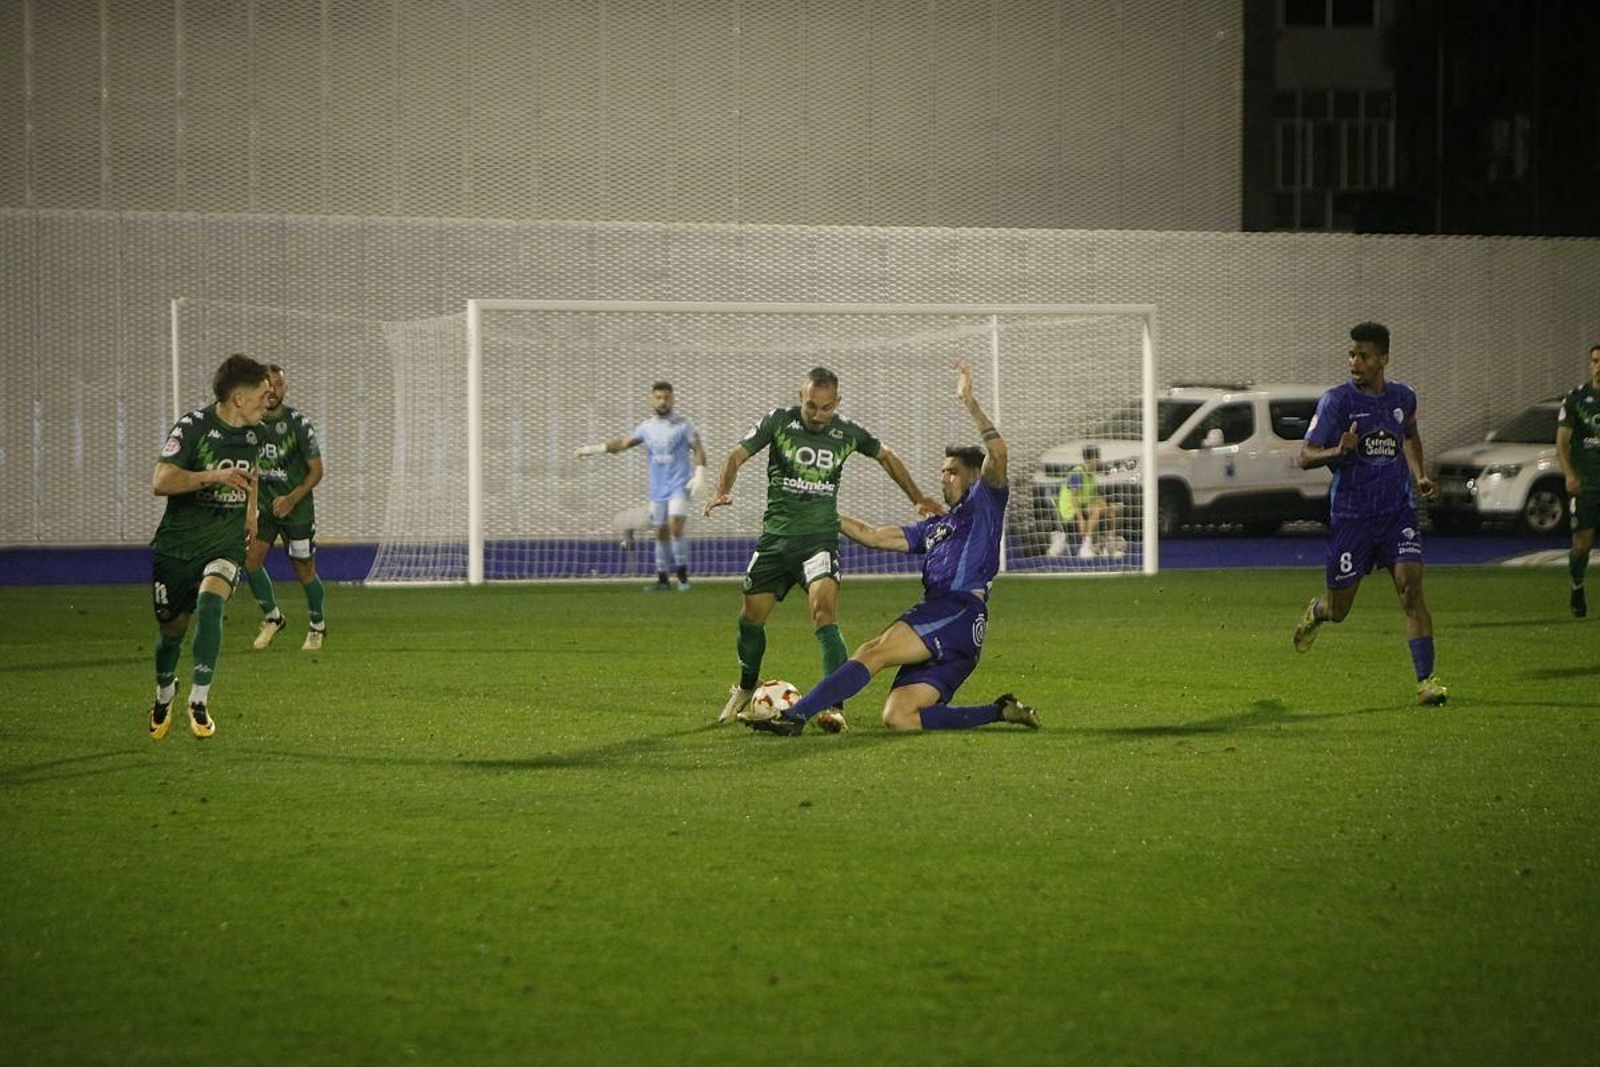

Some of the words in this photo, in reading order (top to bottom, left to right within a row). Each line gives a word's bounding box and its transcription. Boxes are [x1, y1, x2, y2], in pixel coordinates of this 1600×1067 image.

[796, 446, 834, 469] OB
[783, 477, 835, 490] columbia
[1340, 551, 1352, 572] 8
